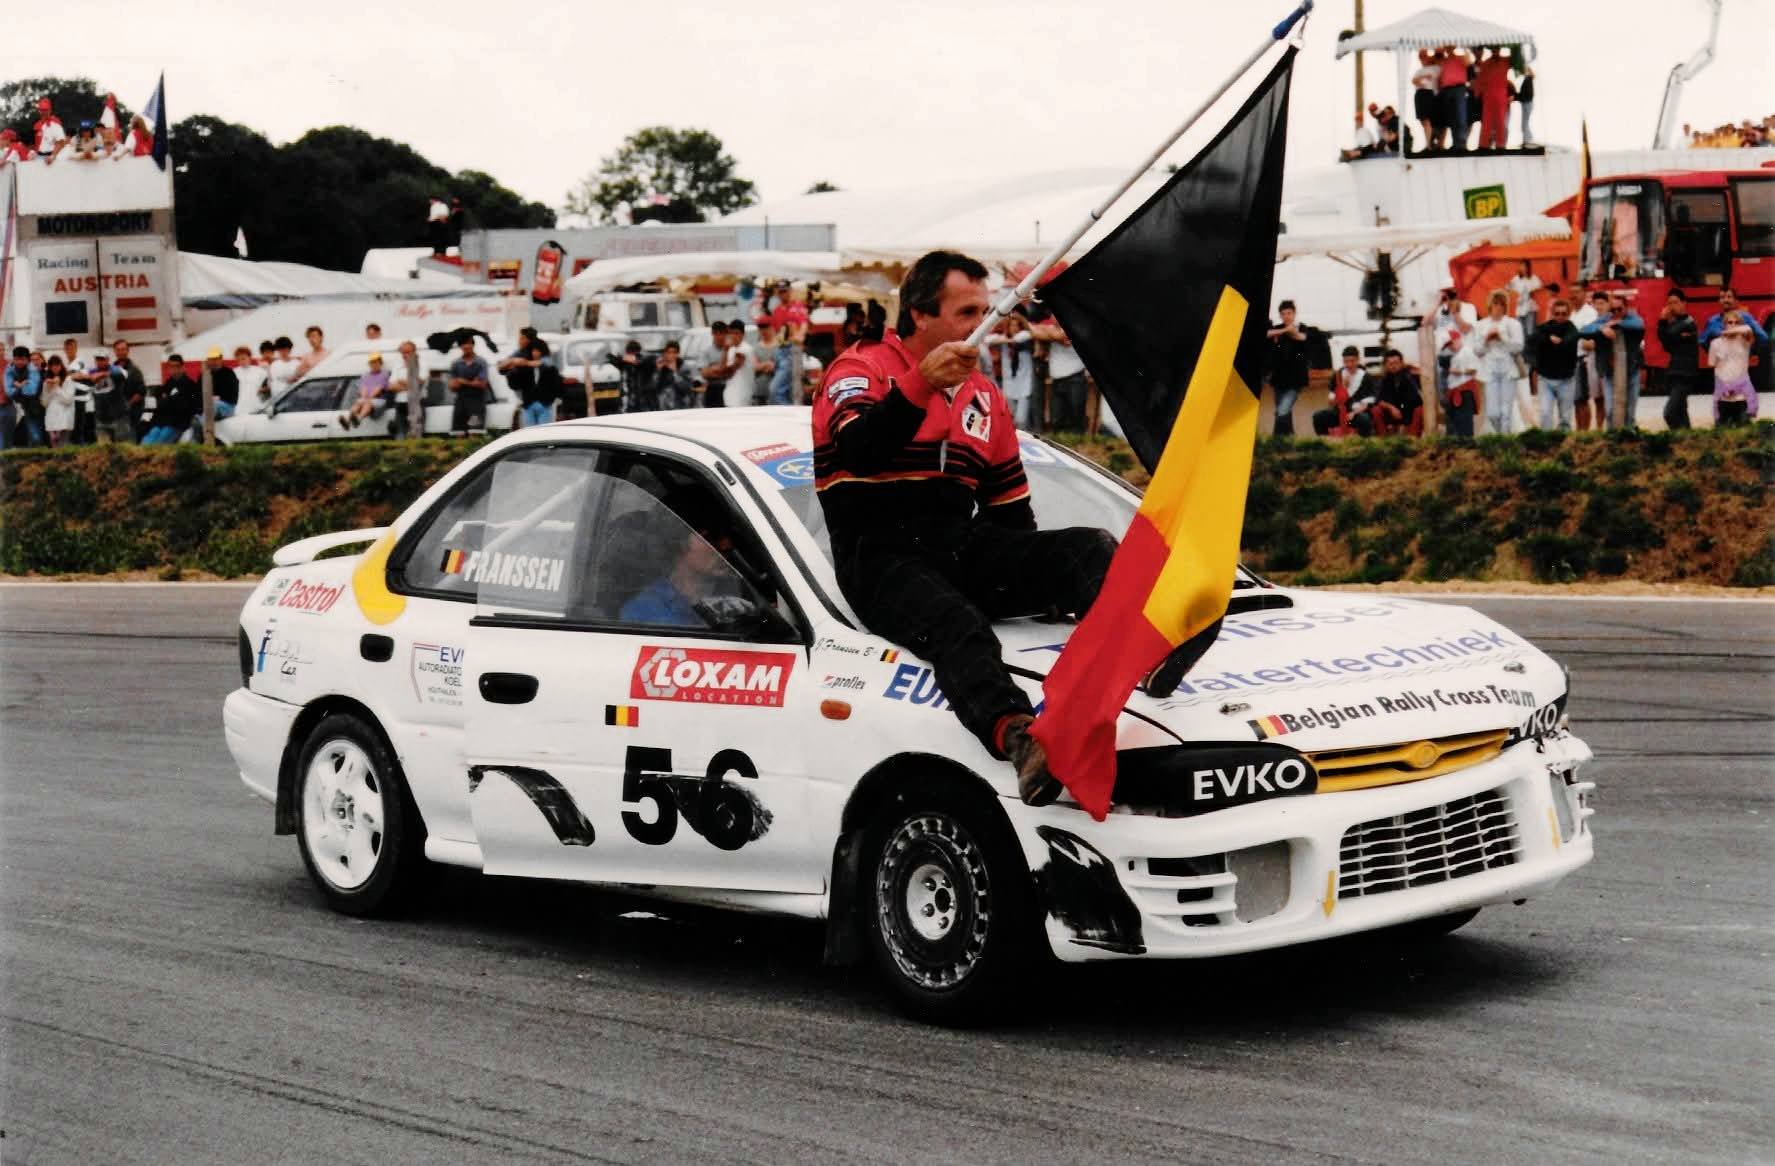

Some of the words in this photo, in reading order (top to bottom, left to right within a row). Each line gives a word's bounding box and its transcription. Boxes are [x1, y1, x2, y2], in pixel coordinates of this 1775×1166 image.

[1474, 196, 1499, 219] BP
[37, 257, 89, 270] Racing
[112, 253, 156, 265] Team
[54, 273, 150, 294] AUSTRIA
[464, 550, 565, 592] FRANSSEN
[278, 578, 346, 613] Castrol
[653, 659, 783, 692] LOXAM
[831, 676, 867, 690] proflex
[681, 692, 778, 705] LOCATION
[1279, 703, 1377, 733] Belgian
[1376, 690, 1437, 714] Rally
[1432, 689, 1491, 706] Cross
[1485, 684, 1537, 708] Team
[1519, 703, 1558, 738] VKO
[1193, 759, 1307, 801] EVKO
[621, 745, 760, 851] 56
